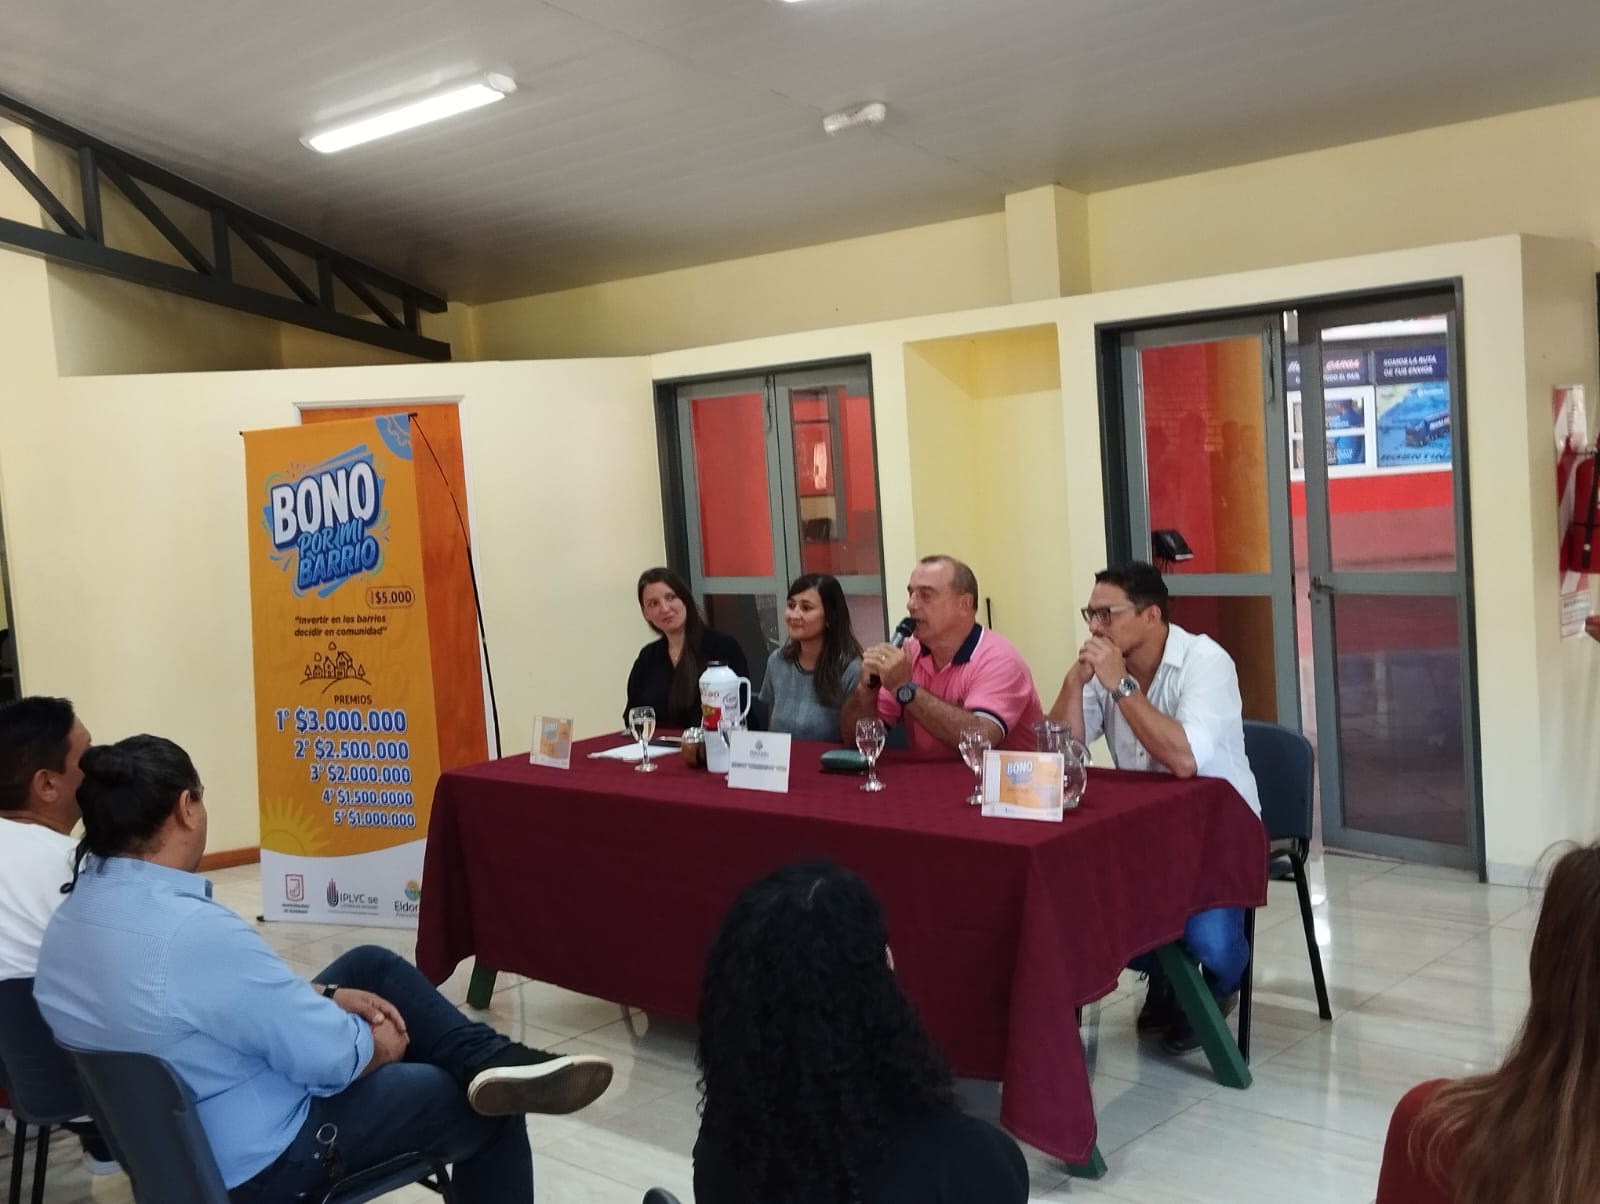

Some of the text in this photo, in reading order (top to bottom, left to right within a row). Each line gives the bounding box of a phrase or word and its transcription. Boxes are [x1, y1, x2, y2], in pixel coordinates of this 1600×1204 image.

[271, 462, 379, 549] BONO
[298, 519, 363, 557] POR MI
[298, 537, 378, 588] BARRIO
[331, 616, 341, 624] en
[343, 614, 355, 623] los
[357, 614, 386, 623] barrios
[294, 628, 322, 637] decidir
[325, 628, 335, 636] en
[334, 694, 373, 705] PREMIOS
[295, 706, 407, 734] $3.000.000
[314, 738, 409, 760] $2.500.000
[327, 762, 411, 784] $2.000.000
[337, 788, 413, 806] $1.500.0000
[348, 810, 415, 828] $1.000.000
